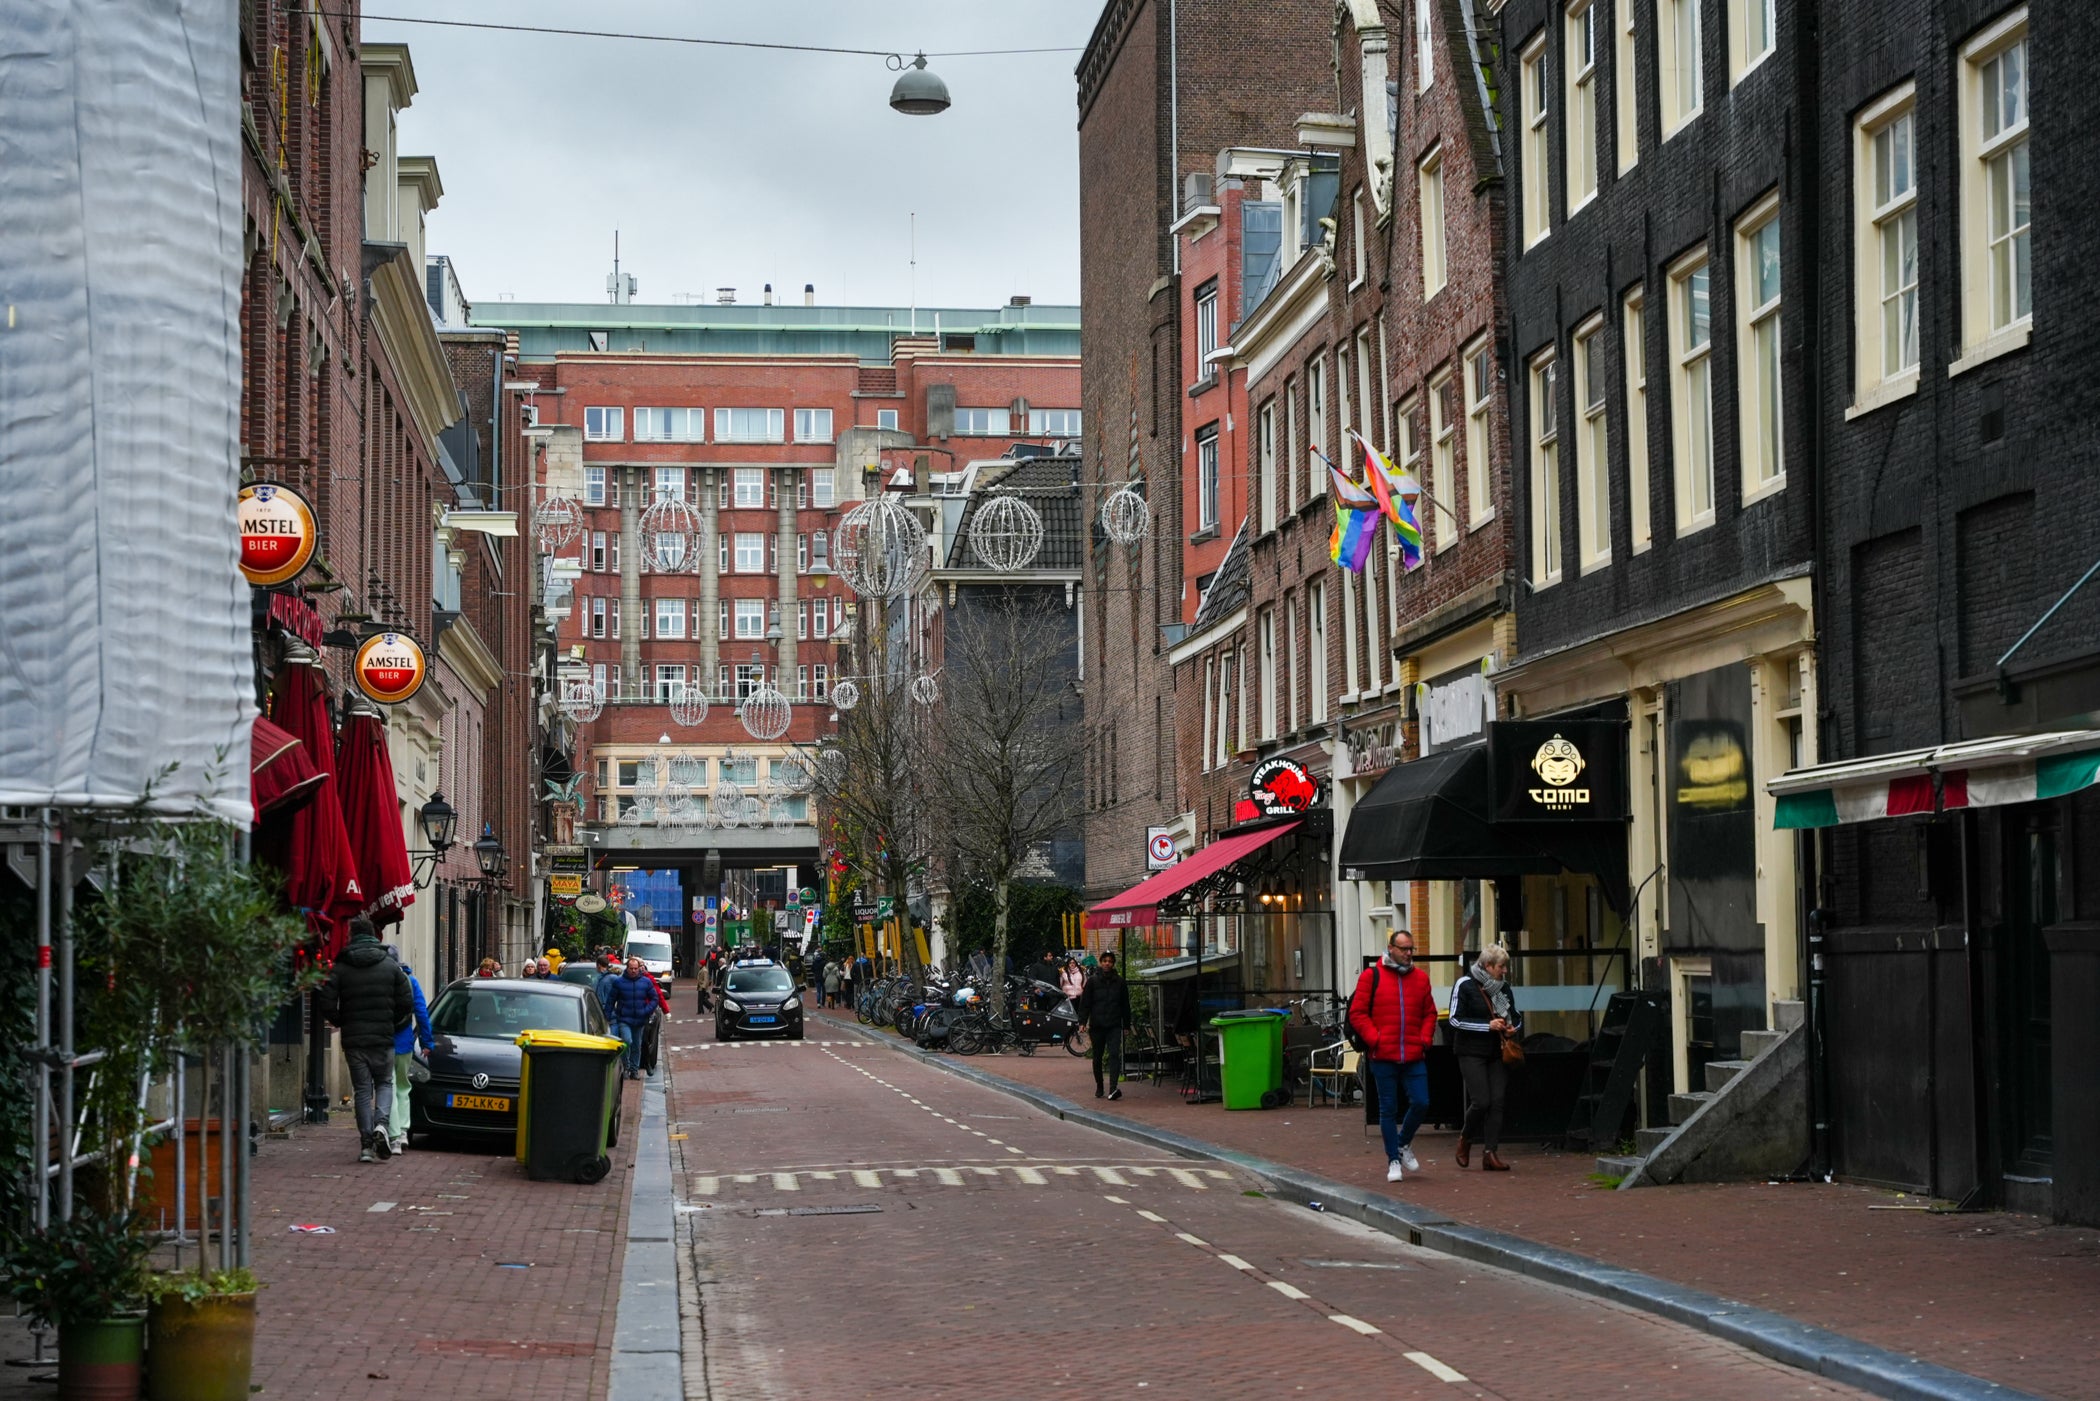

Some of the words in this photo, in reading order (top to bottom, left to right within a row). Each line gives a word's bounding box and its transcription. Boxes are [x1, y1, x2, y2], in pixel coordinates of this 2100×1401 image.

[240, 519, 297, 534] MSTEL
[248, 540, 278, 551] BIER
[366, 656, 413, 668] AMSTEL
[378, 671, 400, 679] BIER
[1252, 760, 1307, 785] STEAKHOUSE
[1528, 788, 1590, 803] TOMO
[1266, 806, 1295, 815] GRILL
[346, 879, 362, 894] A
[553, 880, 579, 888] MAYA
[456, 1096, 505, 1110] 57-LKK-6
